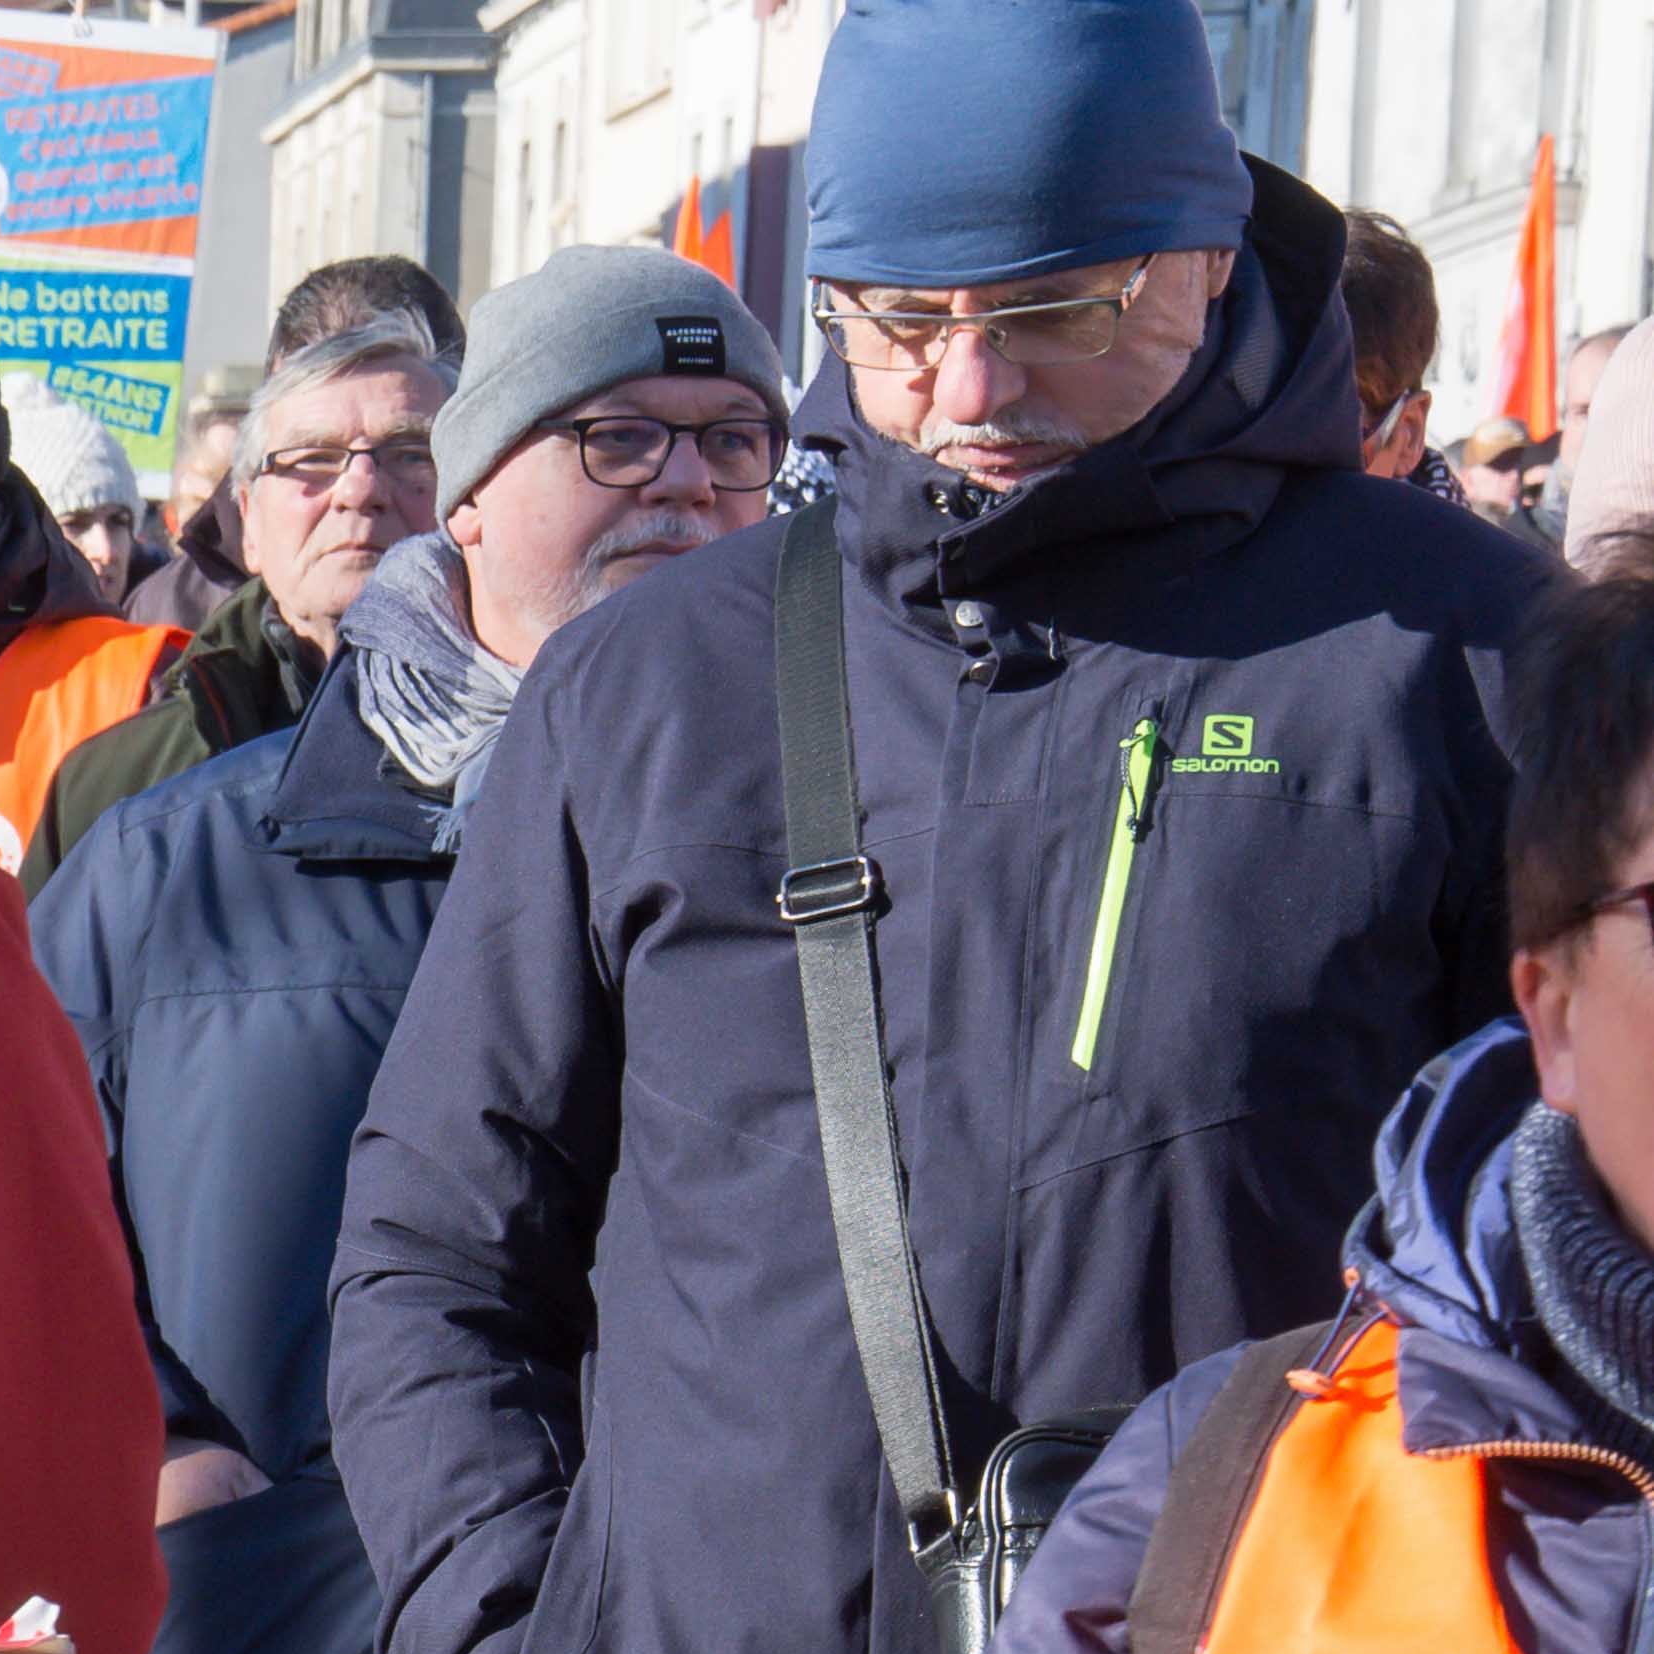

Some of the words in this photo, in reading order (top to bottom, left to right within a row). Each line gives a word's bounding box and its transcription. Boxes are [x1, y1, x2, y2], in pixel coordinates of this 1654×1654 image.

[15, 160, 97, 194] quand
[101, 161, 134, 183] on
[137, 151, 178, 176] est
[5, 193, 91, 222] encore
[35, 279, 170, 314] battons
